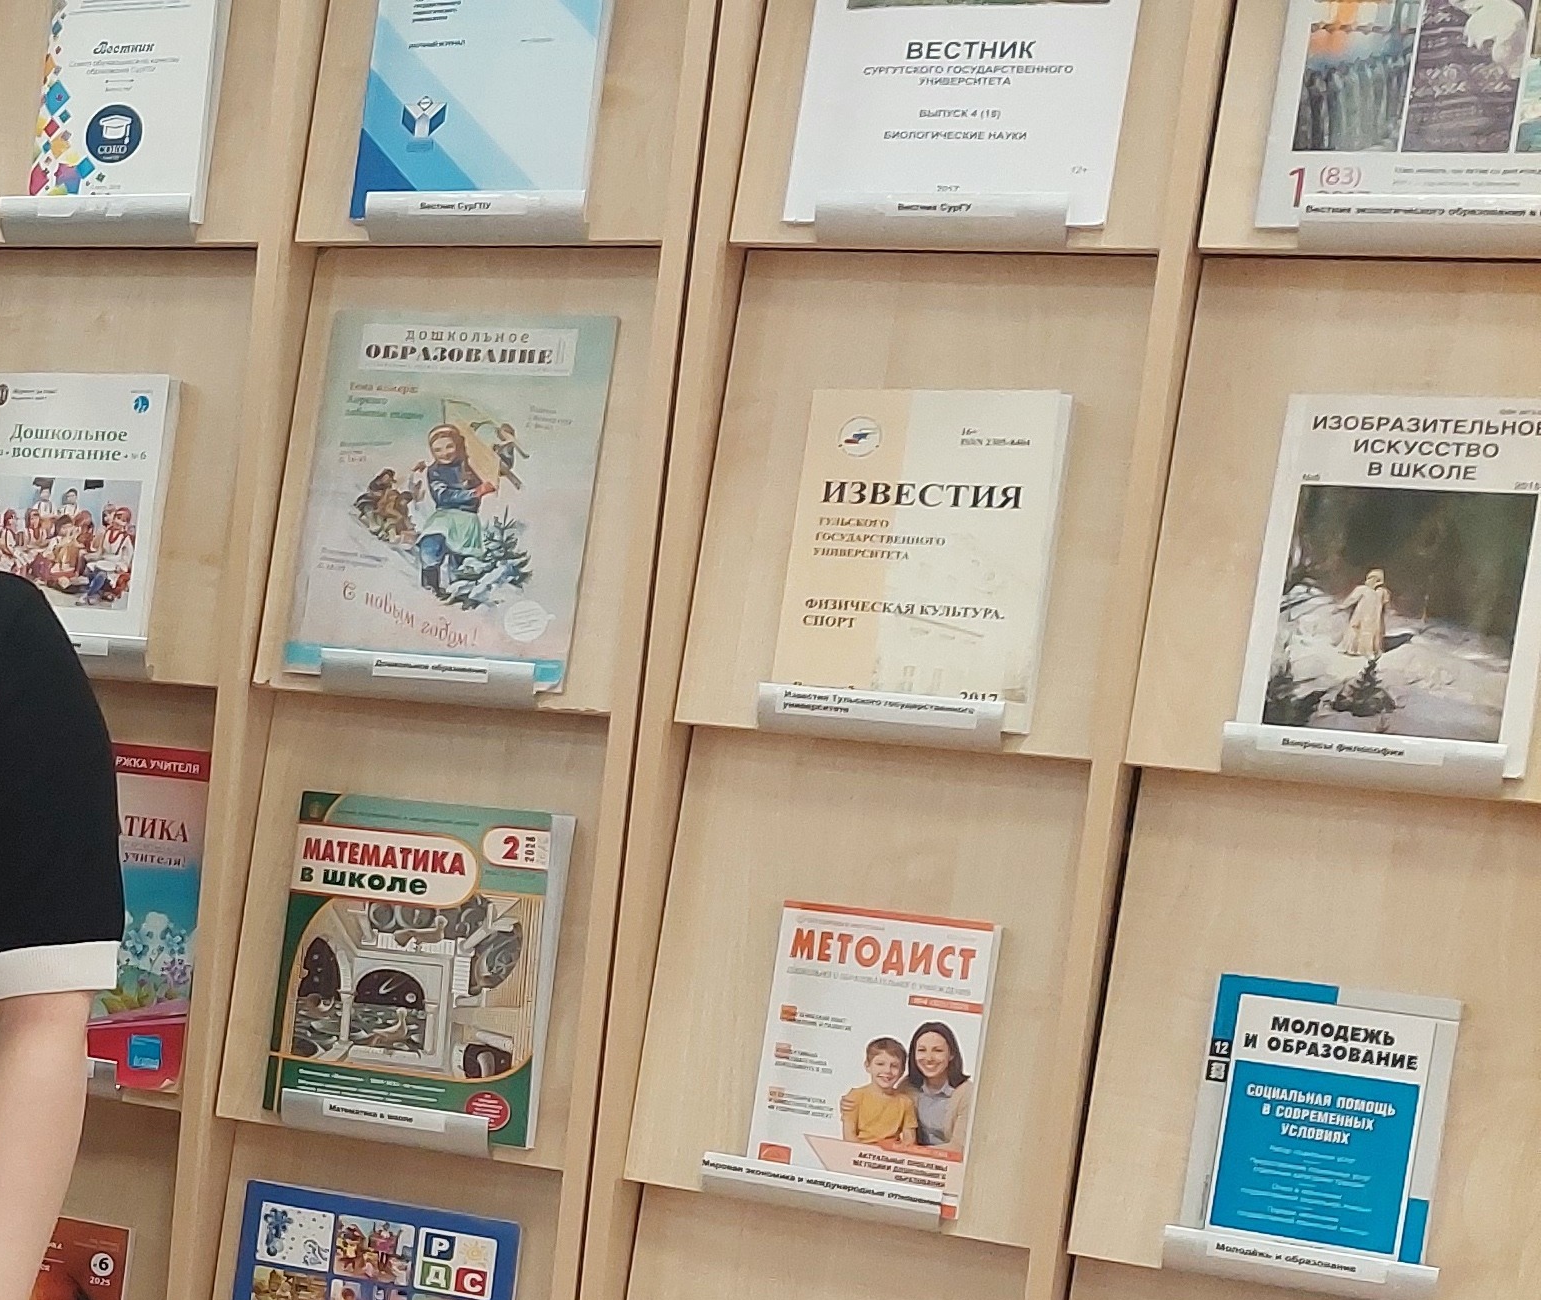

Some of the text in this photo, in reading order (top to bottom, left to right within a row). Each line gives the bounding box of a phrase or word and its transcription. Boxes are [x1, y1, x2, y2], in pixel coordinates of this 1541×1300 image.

[93, 41, 155, 54] Вестник
[906, 40, 1036, 60] ВЕСТНИК
[864, 65, 1073, 75] СУРГУТСКОГО ГОСУДАРСТВЕННОГО
[918, 77, 1011, 85] УНИВЕРСИТЕТА
[919, 110, 968, 118] ВЫПУСК
[884, 131, 985, 139] БИОЛОГИЧЕСКИЕ
[1289, 166, 1362, 207] 1 (83)
[366, 343, 555, 364] ОБРАЗОВАНИЕ
[10, 424, 128, 442] Дошкольное
[12, 447, 121, 461] воспитание
[1353, 439, 1500, 458] ИСКУССТВО
[1368, 462, 1478, 480] В ШКОЛЕ
[820, 480, 1024, 510] ИЗВЕСТИЯ
[819, 517, 889, 528] ТУЛЬСКОГО
[815, 532, 946, 546] ГОСУДАРСТВЕННОГО
[813, 547, 909, 560] УНИВЕРСИТЕТА
[805, 598, 1005, 620] ФИЗИЧЕСКАЯ КУЛЬТУРА.
[803, 615, 857, 629] СПОРТ
[150, 760, 199, 774] УЧИТЕЛЯ
[125, 815, 188, 842] ТИКА
[303, 836, 519, 875] МАТЕМАТИКА 2
[300, 867, 427, 895] в школе
[790, 928, 977, 980] МЕТОДИСТ
[1271, 1016, 1395, 1046] МОЛОДЕЖЬ
[1214, 1041, 1229, 1055] 12
[1244, 1033, 1419, 1070] И ОБРАЗОВАНИЕ
[1246, 1083, 1396, 1116] СОЦИАЛЬНАЯ ПОМОЩЬ
[1262, 1103, 1374, 1131] В СОВРЕМЕННЫХ
[1280, 1123, 1351, 1144] УСЛОВИЯХ
[702, 1159, 743, 1172] Мировая
